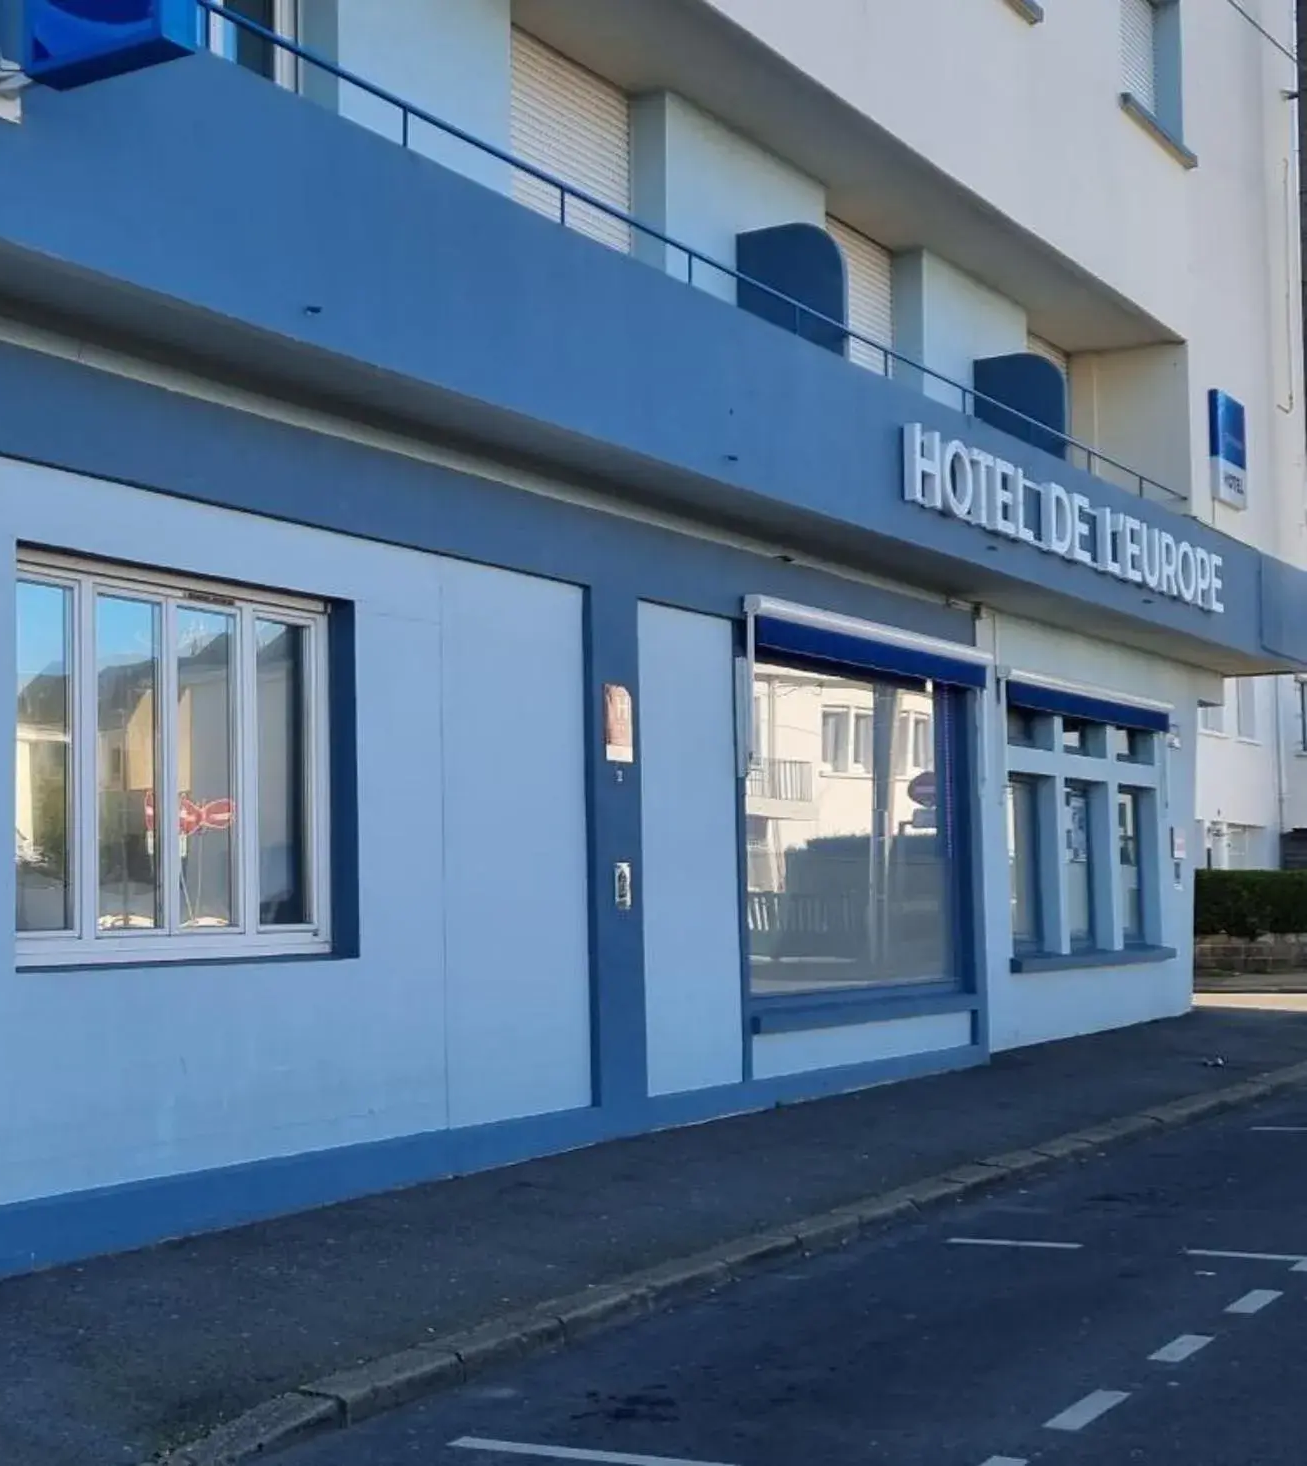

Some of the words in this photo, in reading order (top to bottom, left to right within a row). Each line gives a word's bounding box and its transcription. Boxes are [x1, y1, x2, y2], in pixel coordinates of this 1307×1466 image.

[904, 422, 1034, 542] HOTEL
[1043, 481, 1092, 564] DE
[1096, 506, 1224, 613] L'EUROPE
